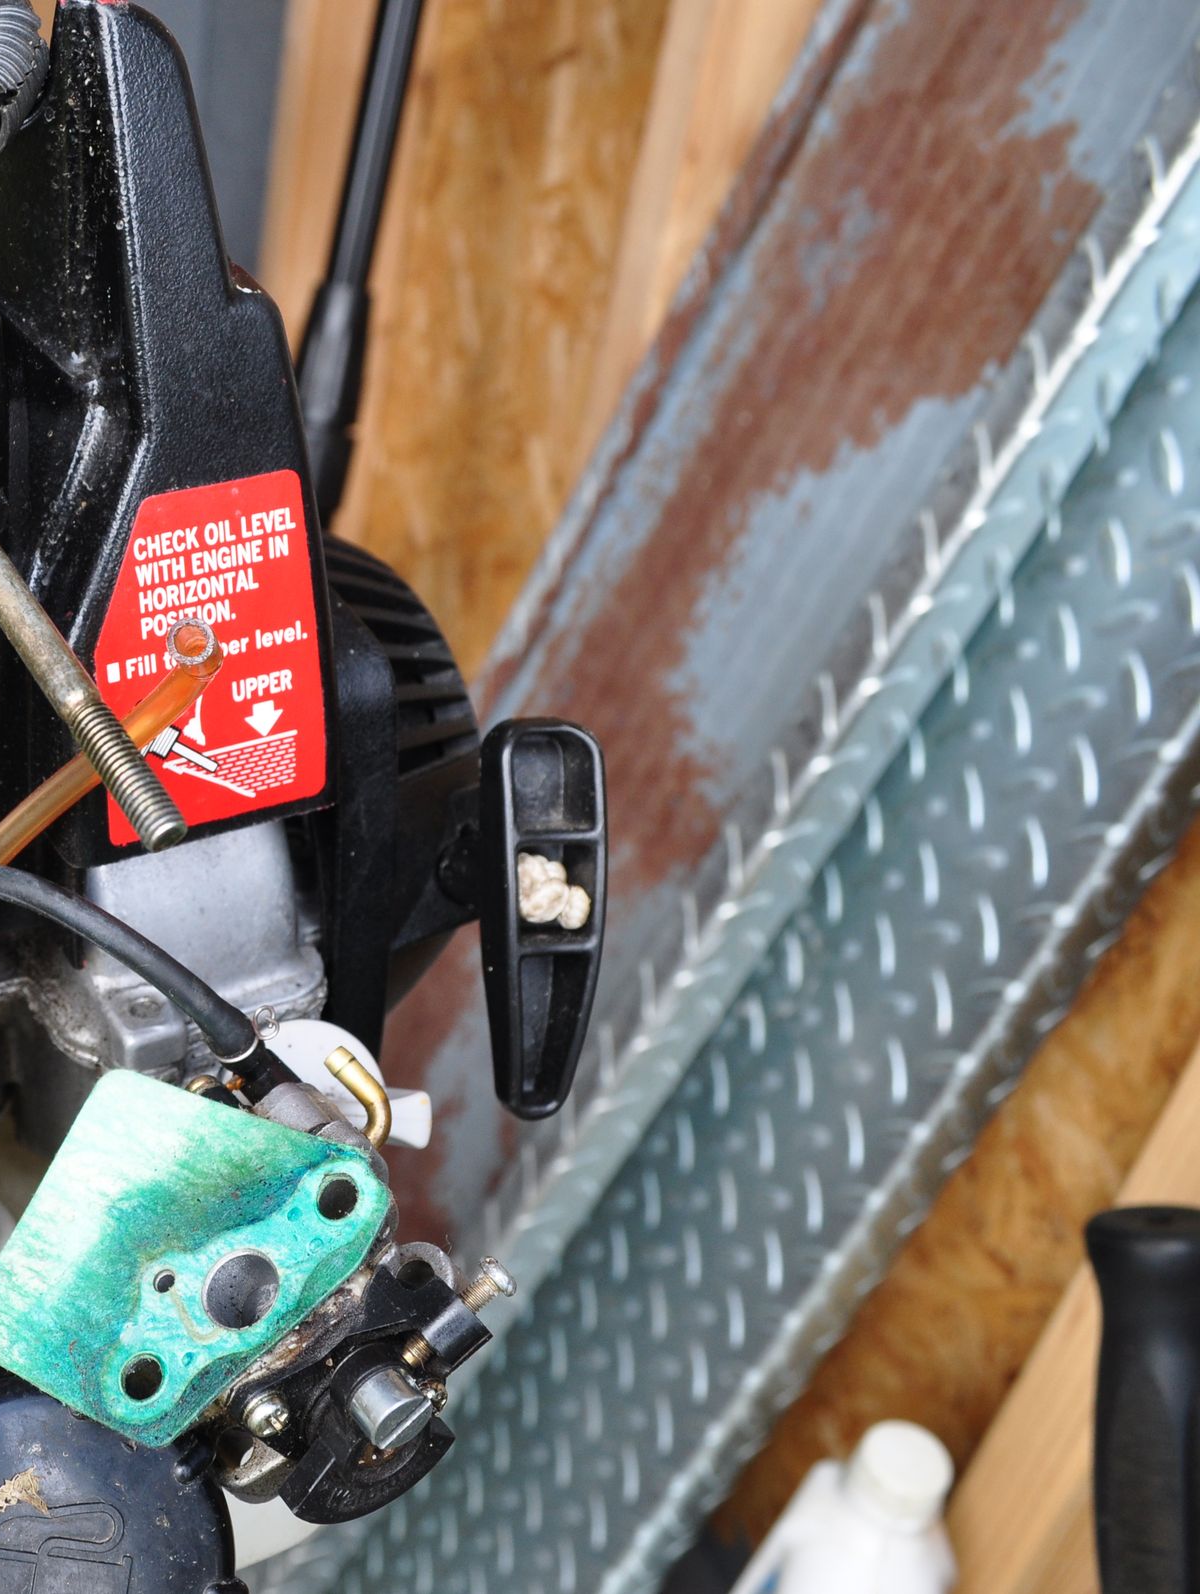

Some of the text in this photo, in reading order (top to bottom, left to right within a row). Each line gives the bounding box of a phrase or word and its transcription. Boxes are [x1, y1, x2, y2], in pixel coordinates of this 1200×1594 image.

[133, 507, 296, 561] CHECK OIL LEVEL
[135, 534, 289, 587] WITH ENGINE IN
[138, 568, 259, 614] HORIZONTAL
[125, 653, 157, 680] Fill
[255, 620, 308, 649] level.
[231, 669, 293, 702] UPPER
